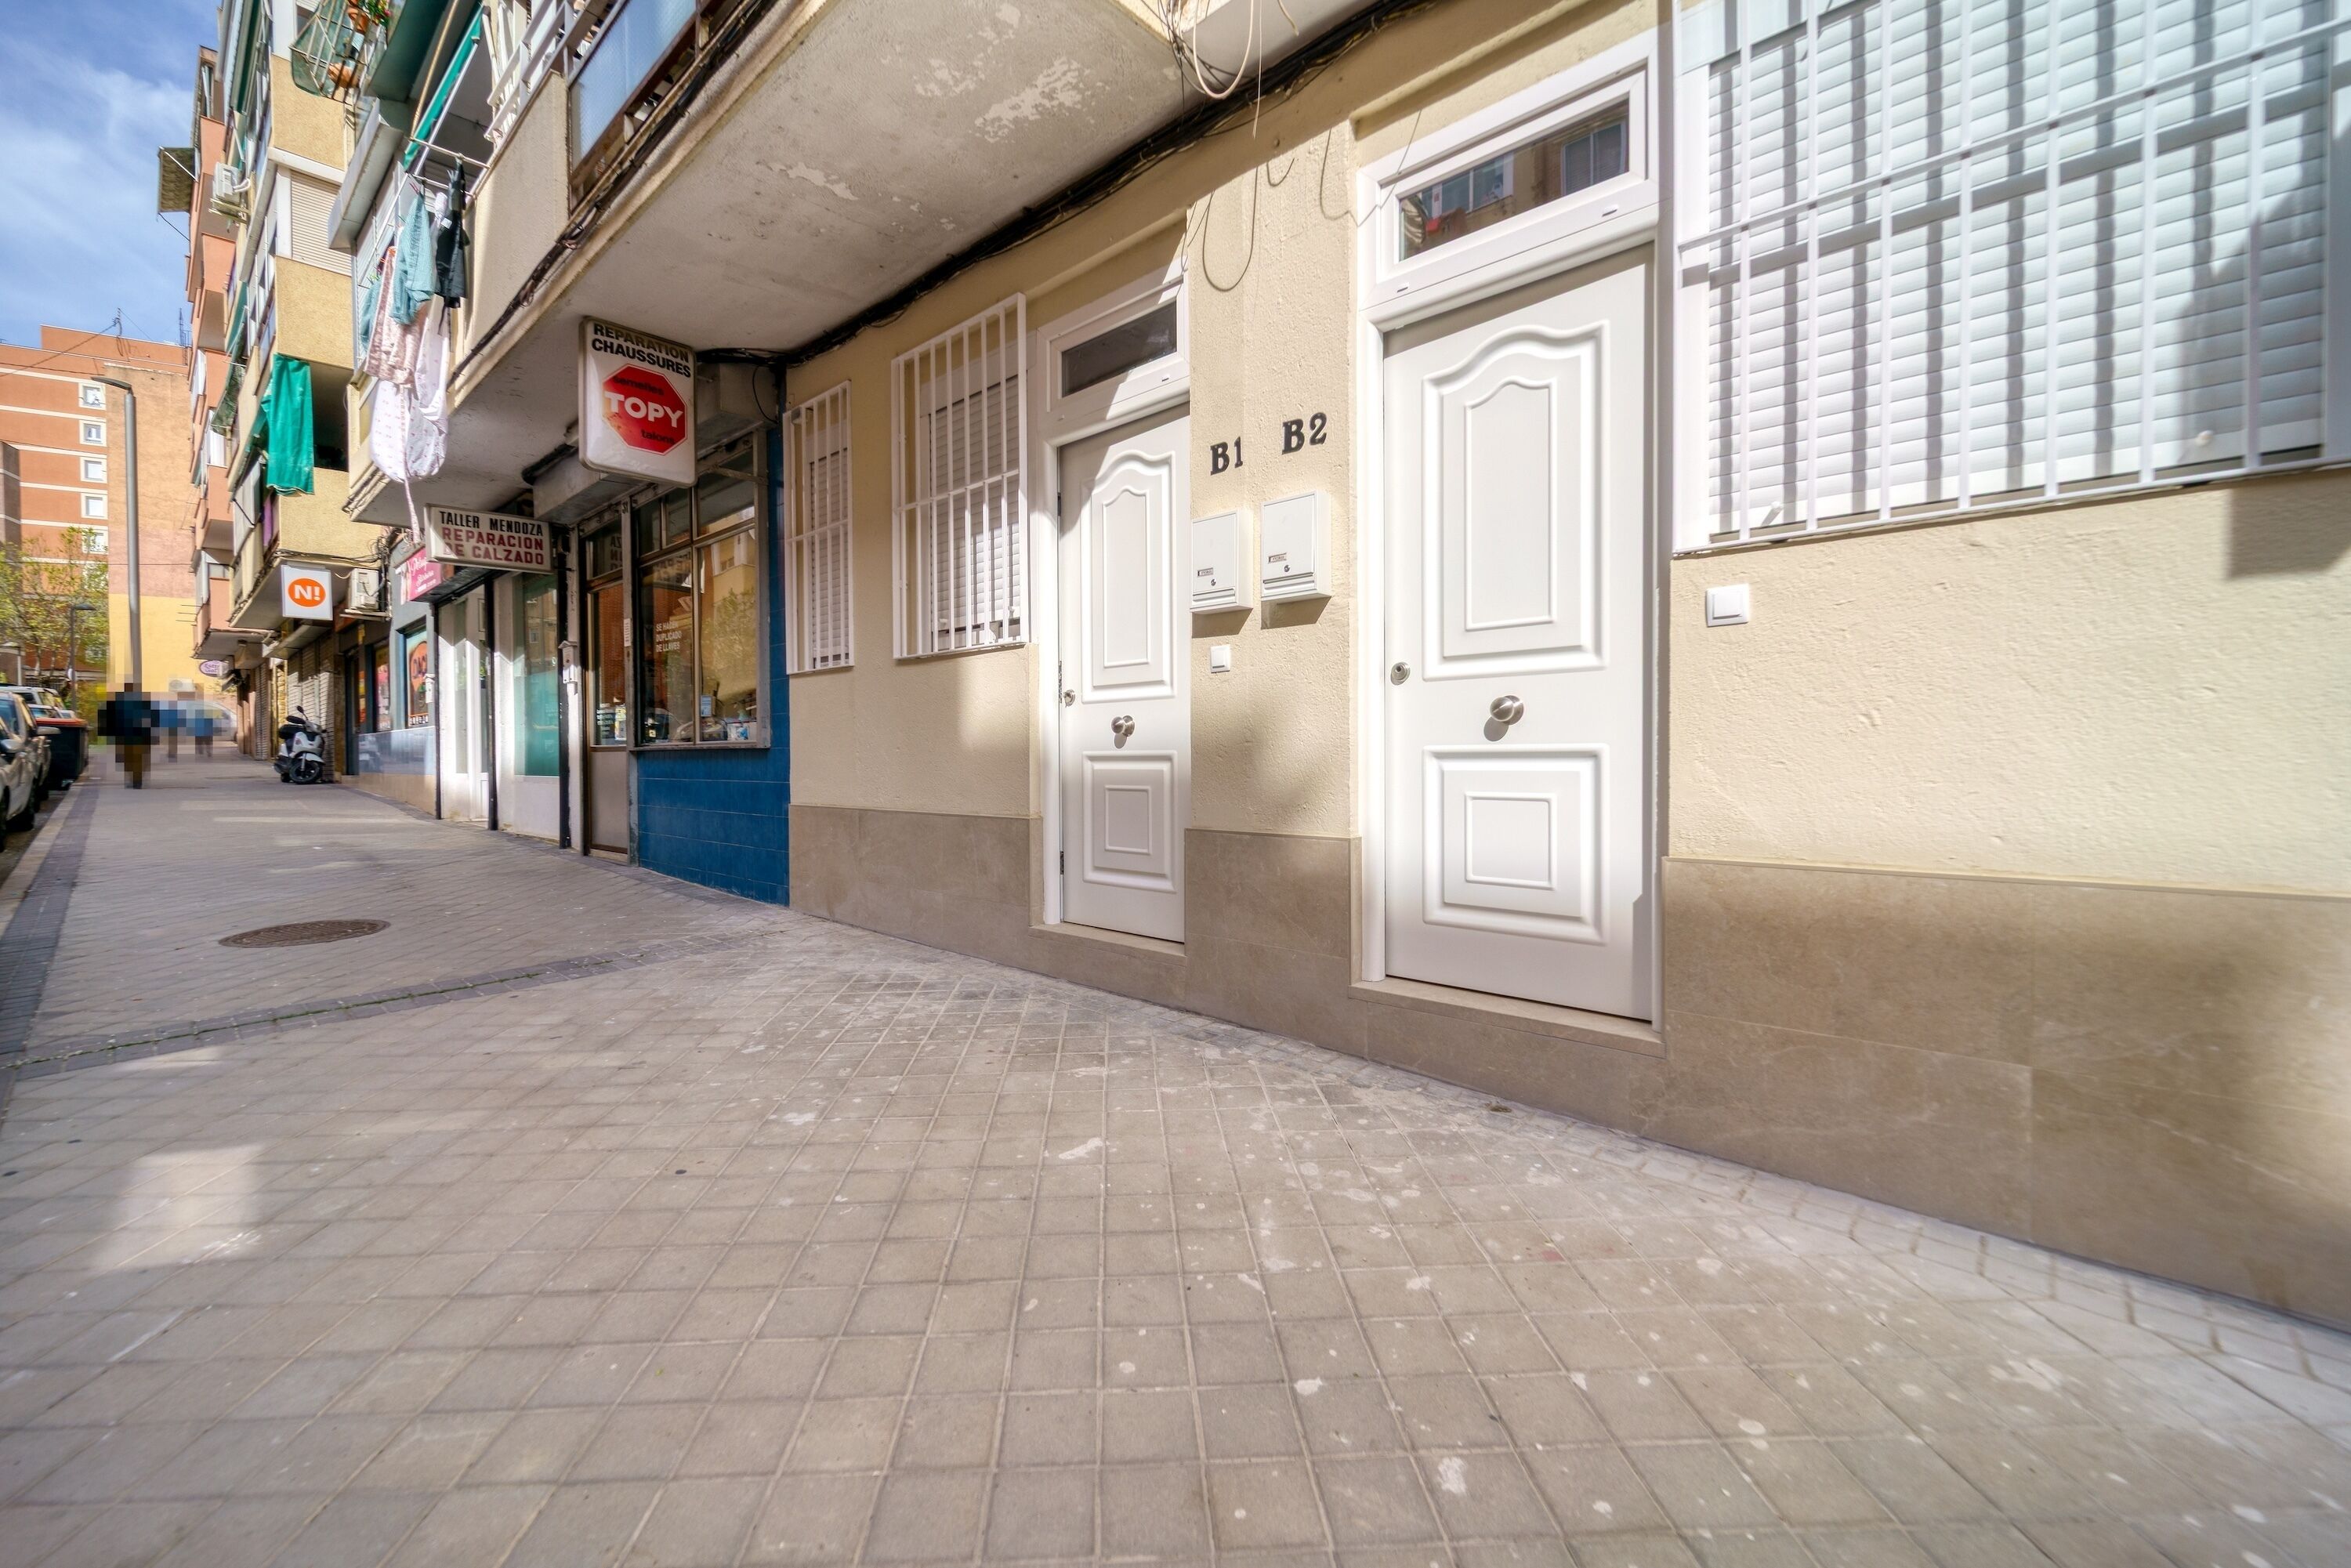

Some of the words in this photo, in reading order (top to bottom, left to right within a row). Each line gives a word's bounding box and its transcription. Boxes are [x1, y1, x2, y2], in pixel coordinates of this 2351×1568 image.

[593, 323, 690, 363] REPARATION
[592, 338, 691, 378] CHAUSSURES
[612, 375, 665, 396] semelles
[603, 391, 683, 428] TOPY
[640, 429, 676, 445] talons
[1282, 411, 1327, 455] B2
[1209, 436, 1244, 476] B1
[440, 511, 480, 529] TALLER
[489, 517, 543, 537] MENDOZA
[441, 527, 543, 551] REPARACION
[443, 542, 465, 557] DE
[472, 545, 544, 565] CALZADO
[655, 623, 662, 632] SE
[655, 644, 663, 653] DE
[663, 641, 680, 651] LLAVES
